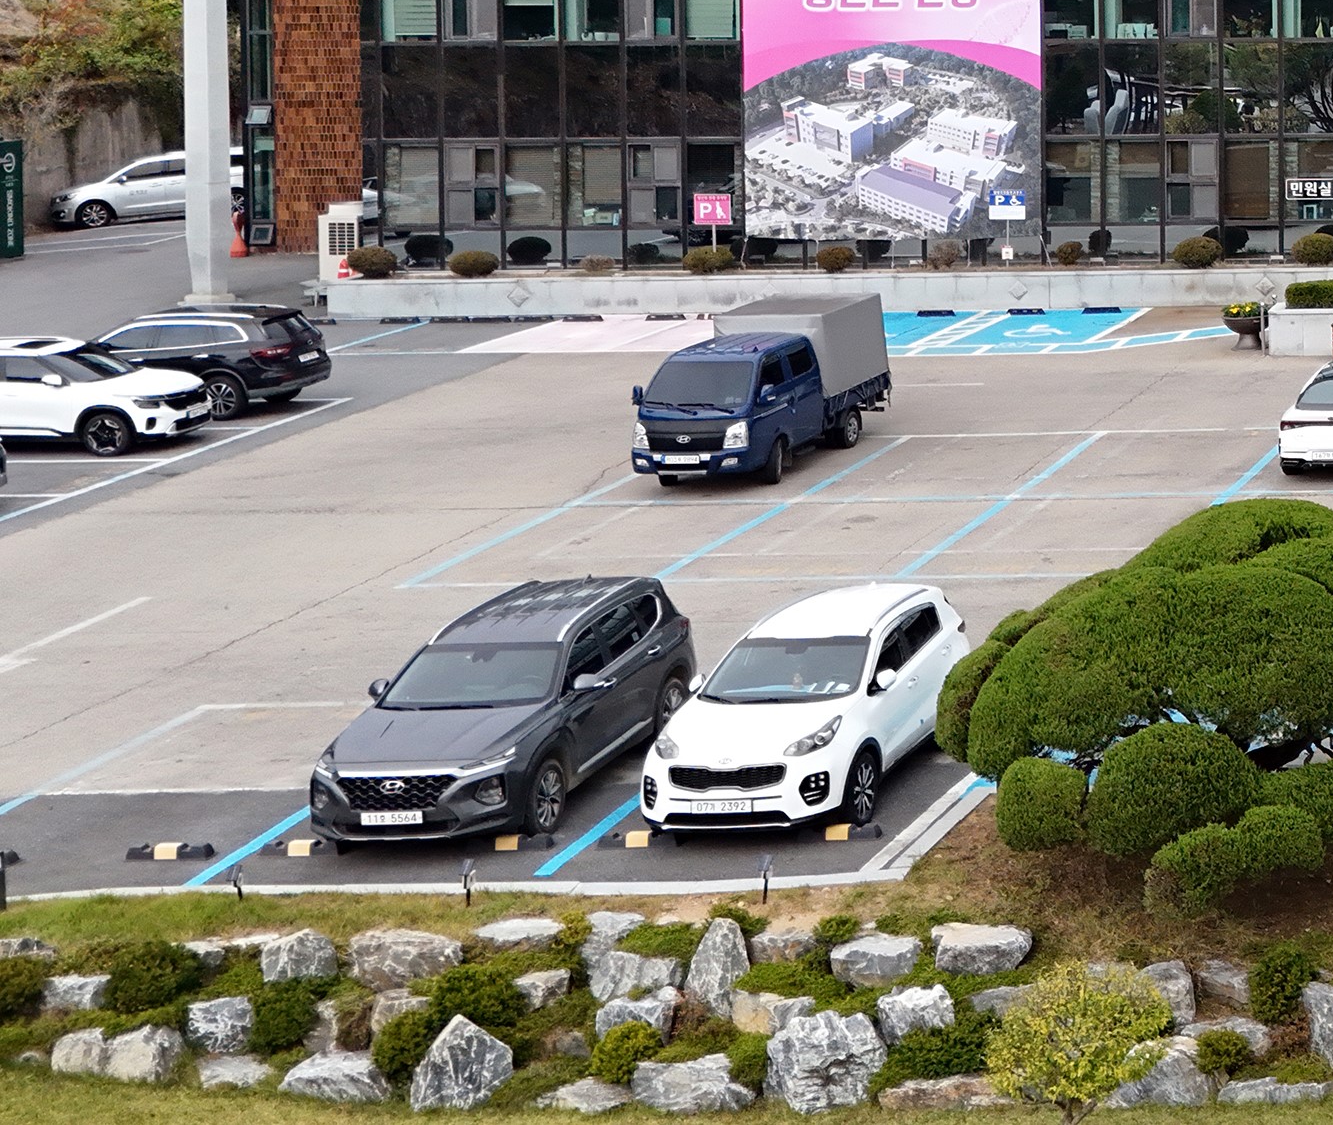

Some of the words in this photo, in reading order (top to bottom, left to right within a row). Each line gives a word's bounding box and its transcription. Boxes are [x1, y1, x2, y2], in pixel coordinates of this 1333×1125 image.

[1290, 181, 1332, 197] 민원실
[995, 195, 1005, 206] P
[699, 202, 712, 219] P
[720, 801, 746, 811] 2392
[391, 813, 417, 823] 5564
